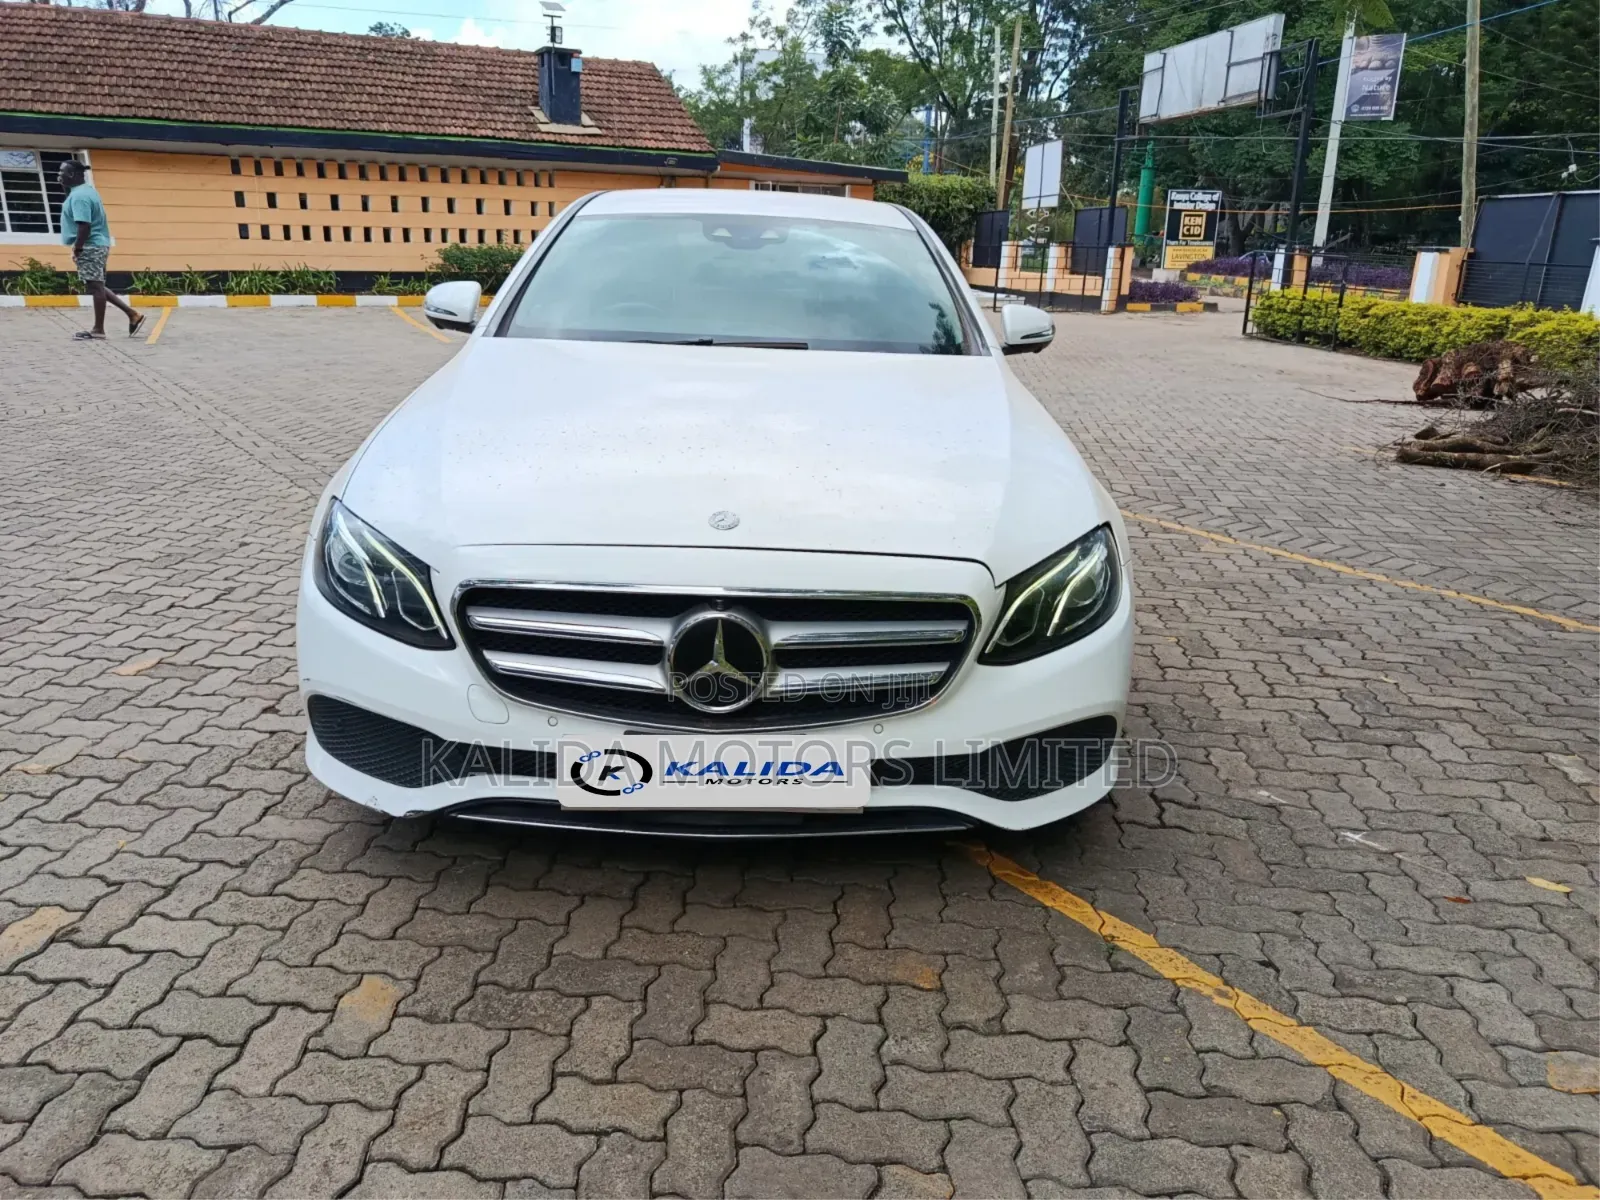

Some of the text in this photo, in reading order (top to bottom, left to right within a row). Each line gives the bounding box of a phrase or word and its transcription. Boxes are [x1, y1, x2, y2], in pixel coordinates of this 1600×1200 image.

[1212, 193, 1220, 201] of
[1184, 216, 1203, 226] KEN
[1183, 226, 1201, 235] CID
[664, 761, 844, 777] KALIDA
